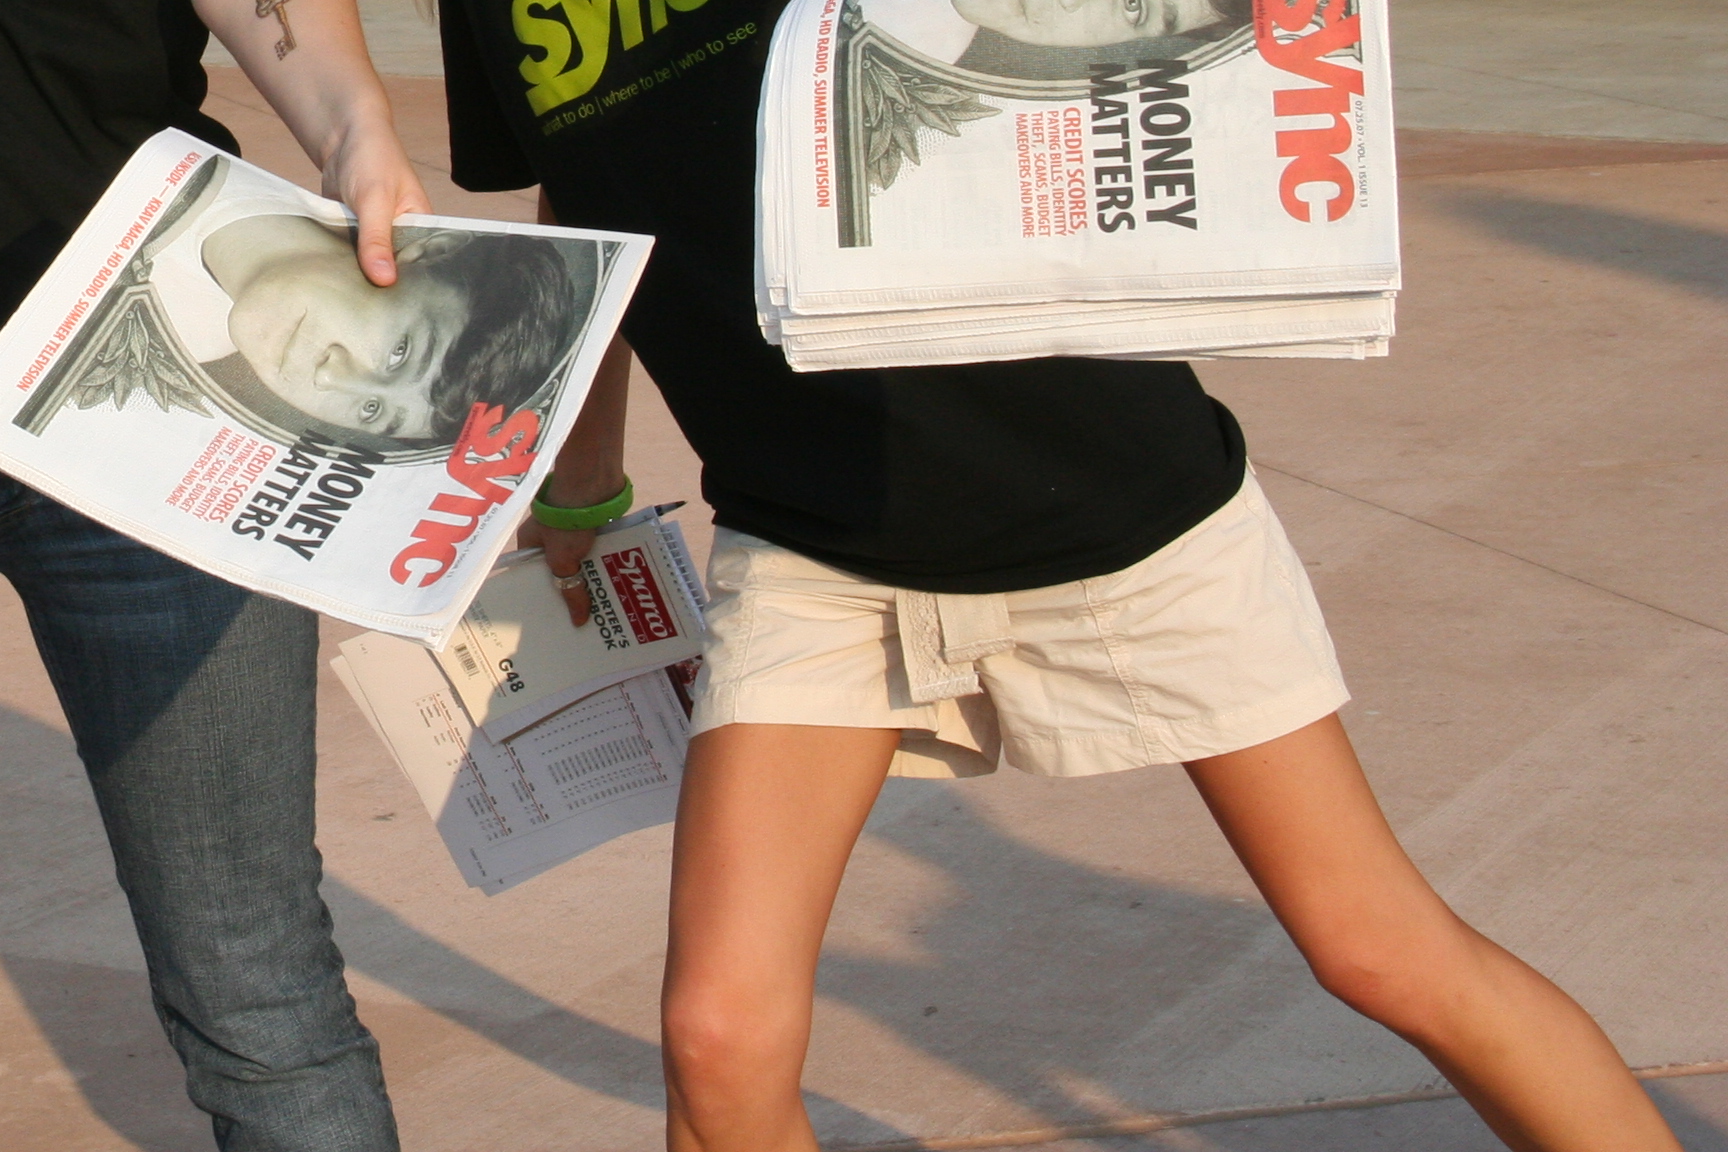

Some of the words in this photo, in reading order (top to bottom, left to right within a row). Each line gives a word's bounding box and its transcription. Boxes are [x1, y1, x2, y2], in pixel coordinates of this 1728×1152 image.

[818, 20, 831, 35] HD
[563, 111, 576, 124] to
[578, 101, 595, 118] do
[602, 83, 639, 108] where
[639, 75, 654, 89] to
[653, 67, 671, 83] be
[678, 49, 706, 70] who
[706, 40, 724, 55] to
[726, 22, 757, 45] see
[812, 37, 829, 78] RADIO,
[813, 79, 825, 133] SUMMER
[1015, 113, 1031, 178] MAKEOVERS
[1029, 112, 1044, 148] THEFT,
[1046, 110, 1060, 150] PAYING
[1062, 107, 1083, 165] CREDIT
[1087, 64, 1135, 233] MATTERS
[1137, 60, 1197, 230] MONEY
[815, 136, 830, 208] TELEVISION
[1032, 152, 1048, 191] SCAMS,
[1048, 152, 1063, 185] BILLS,
[1358, 171, 1366, 195] ISSUE
[136, 195, 162, 226] KRAV
[1019, 180, 1032, 203] AND
[1051, 188, 1066, 236] IDENTITY
[1066, 168, 1088, 234] SCORES,
[1021, 206, 1035, 238] MORE
[1036, 194, 1050, 237] BUDGET
[113, 220, 145, 253] MAGA,
[104, 250, 123, 270] HD
[79, 265, 112, 301] RADIO,
[52, 297, 90, 343] SUMMER
[15, 339, 60, 392] TELEVISION
[192, 425, 232, 471] MAKEOVERS
[218, 432, 245, 456] THEFT,
[231, 437, 258, 466] PAYING
[238, 442, 277, 484] CREDIT
[180, 467, 200, 486] AND
[197, 455, 225, 483] SCAMS,
[213, 463, 239, 486] BILLS,
[229, 428, 334, 542] MATTERS
[164, 483, 188, 507] MORE
[178, 482, 206, 513] BUDGET
[191, 484, 222, 519] IDENTITY
[203, 479, 248, 525] SCORES,
[272, 443, 385, 561] MONEY
[391, 402, 539, 587] sync
[577, 568, 617, 650] BOOK
[581, 558, 630, 649] REPORTER'S
[602, 556, 646, 643] BRAND
[618, 549, 668, 639] Sparco
[496, 656, 525, 693] G48
